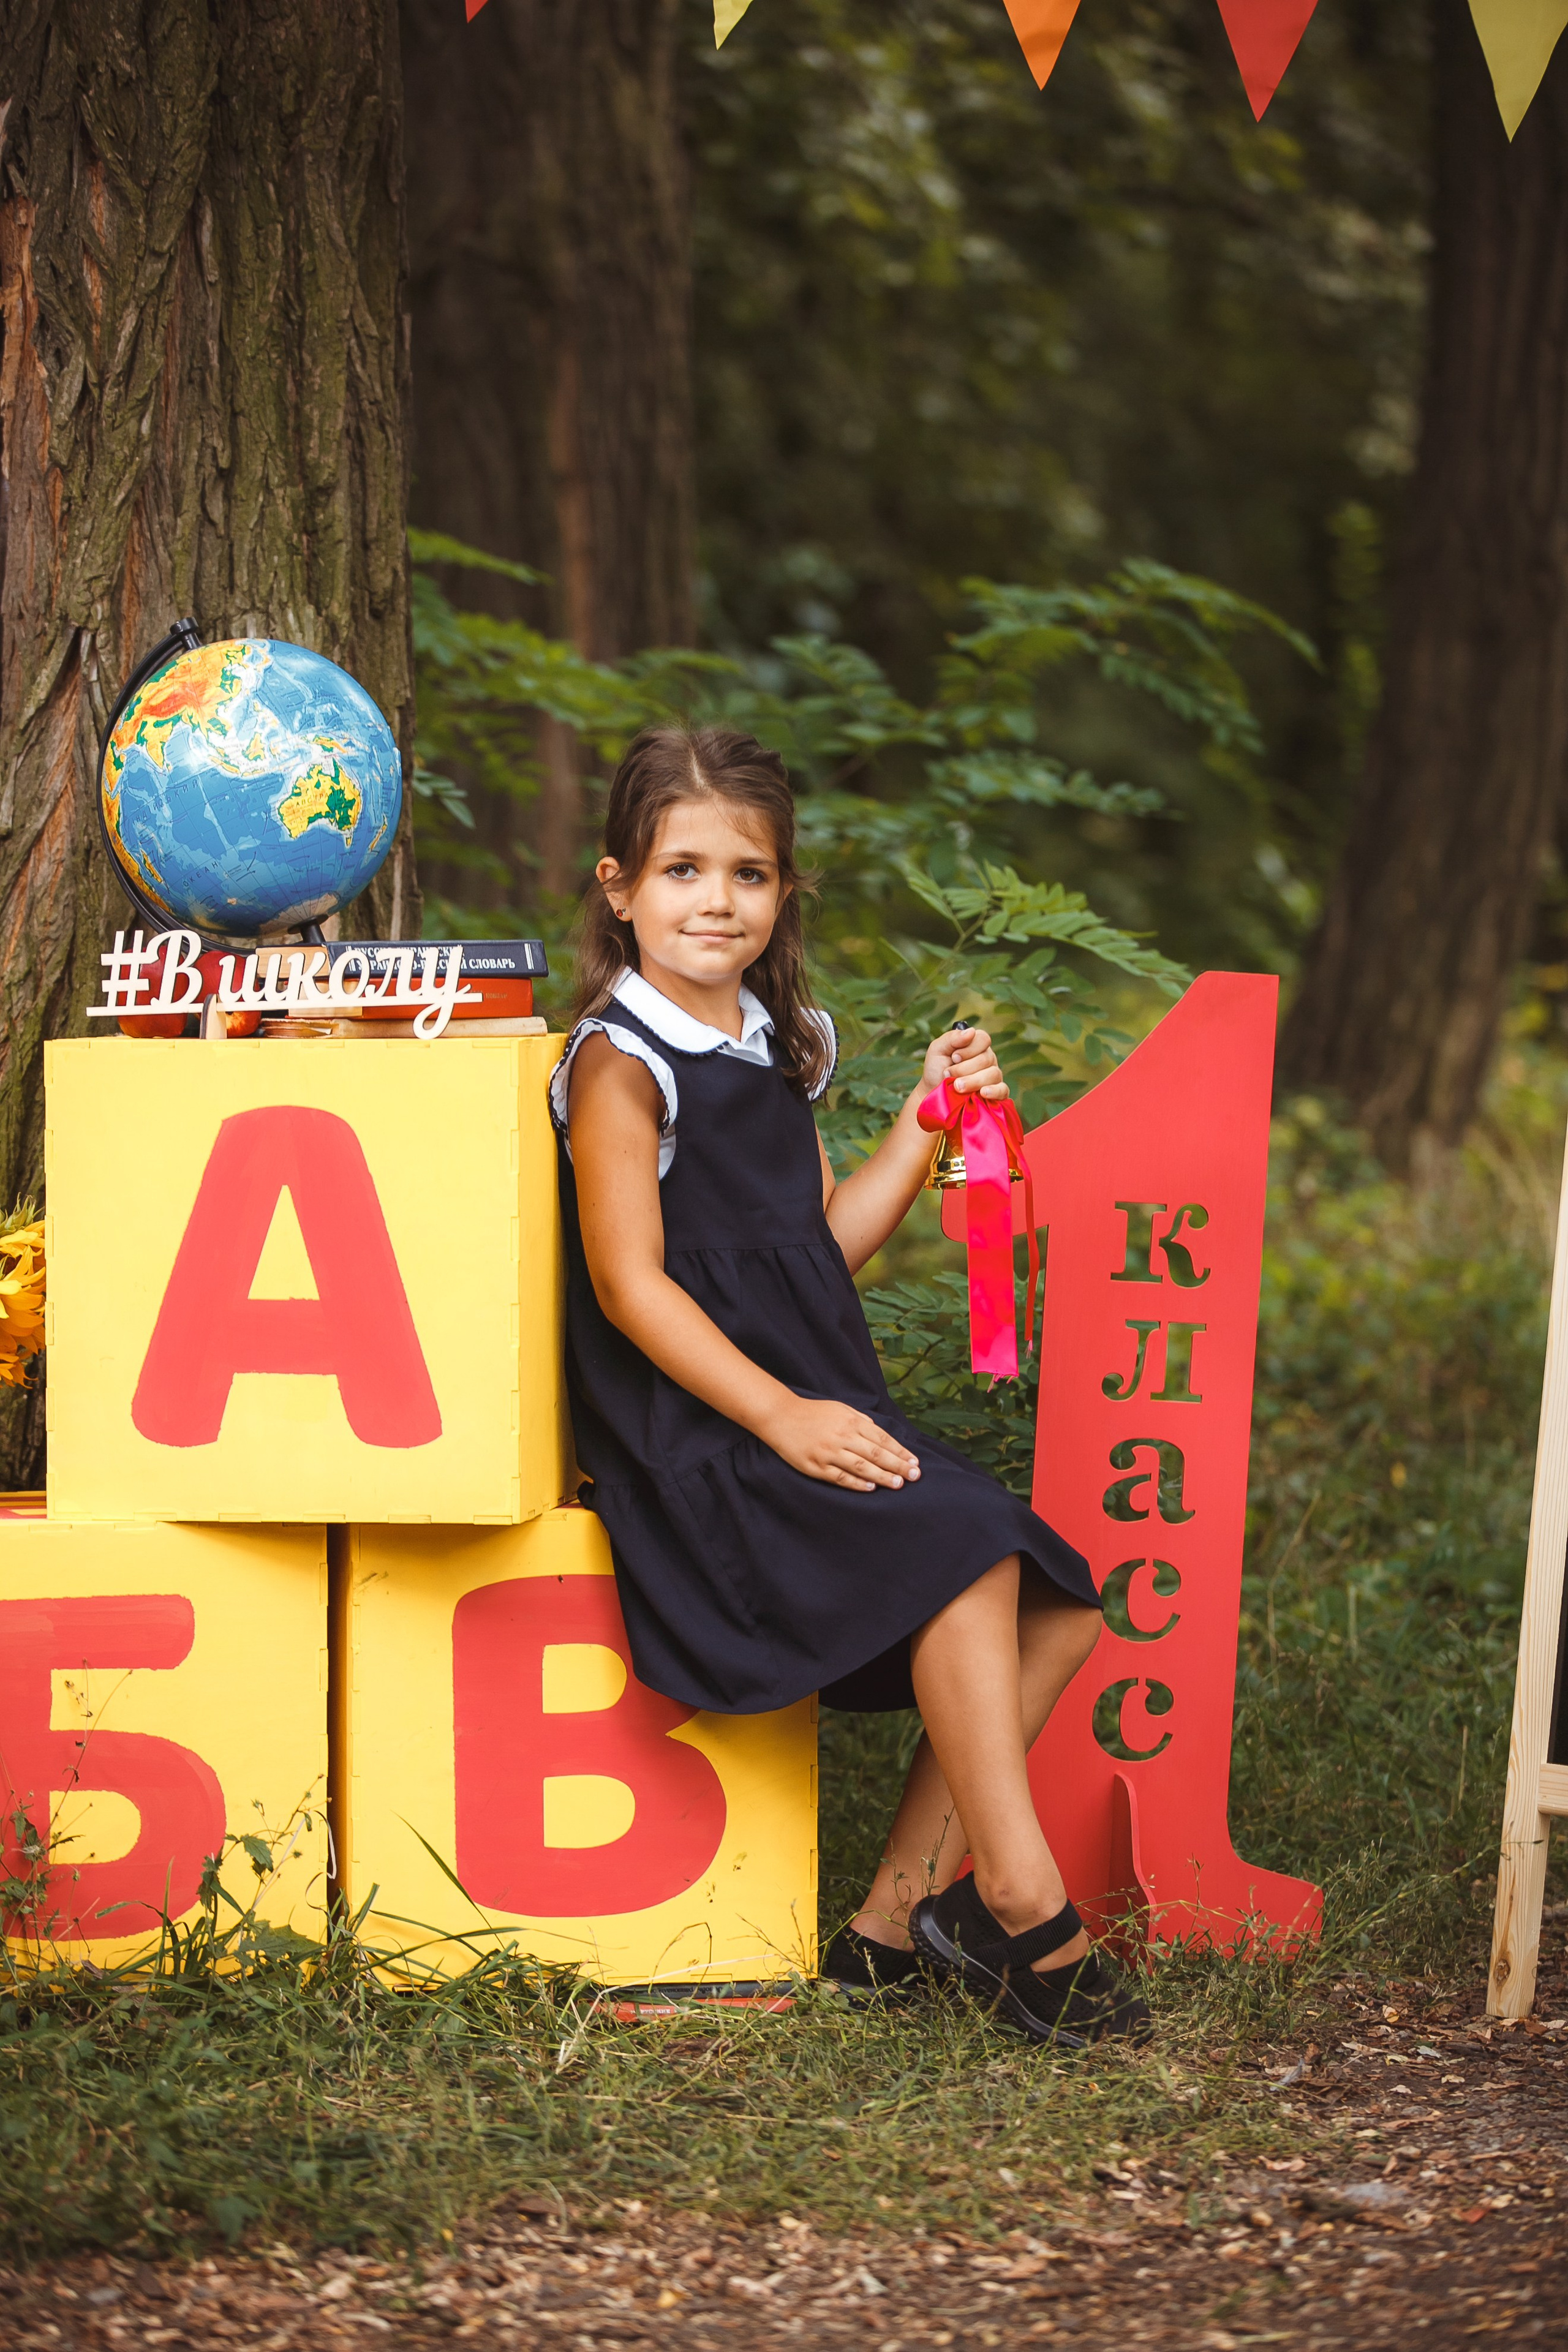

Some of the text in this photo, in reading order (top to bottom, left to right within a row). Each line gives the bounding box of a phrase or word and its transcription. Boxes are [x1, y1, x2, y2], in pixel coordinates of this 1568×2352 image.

[183, 861, 218, 886] ОКЕАН
[219, 945, 471, 1039] школу
[469, 957, 516, 970] СЛОВАРЬ
[131, 1104, 443, 1448] А
[452, 1574, 727, 1918] В
